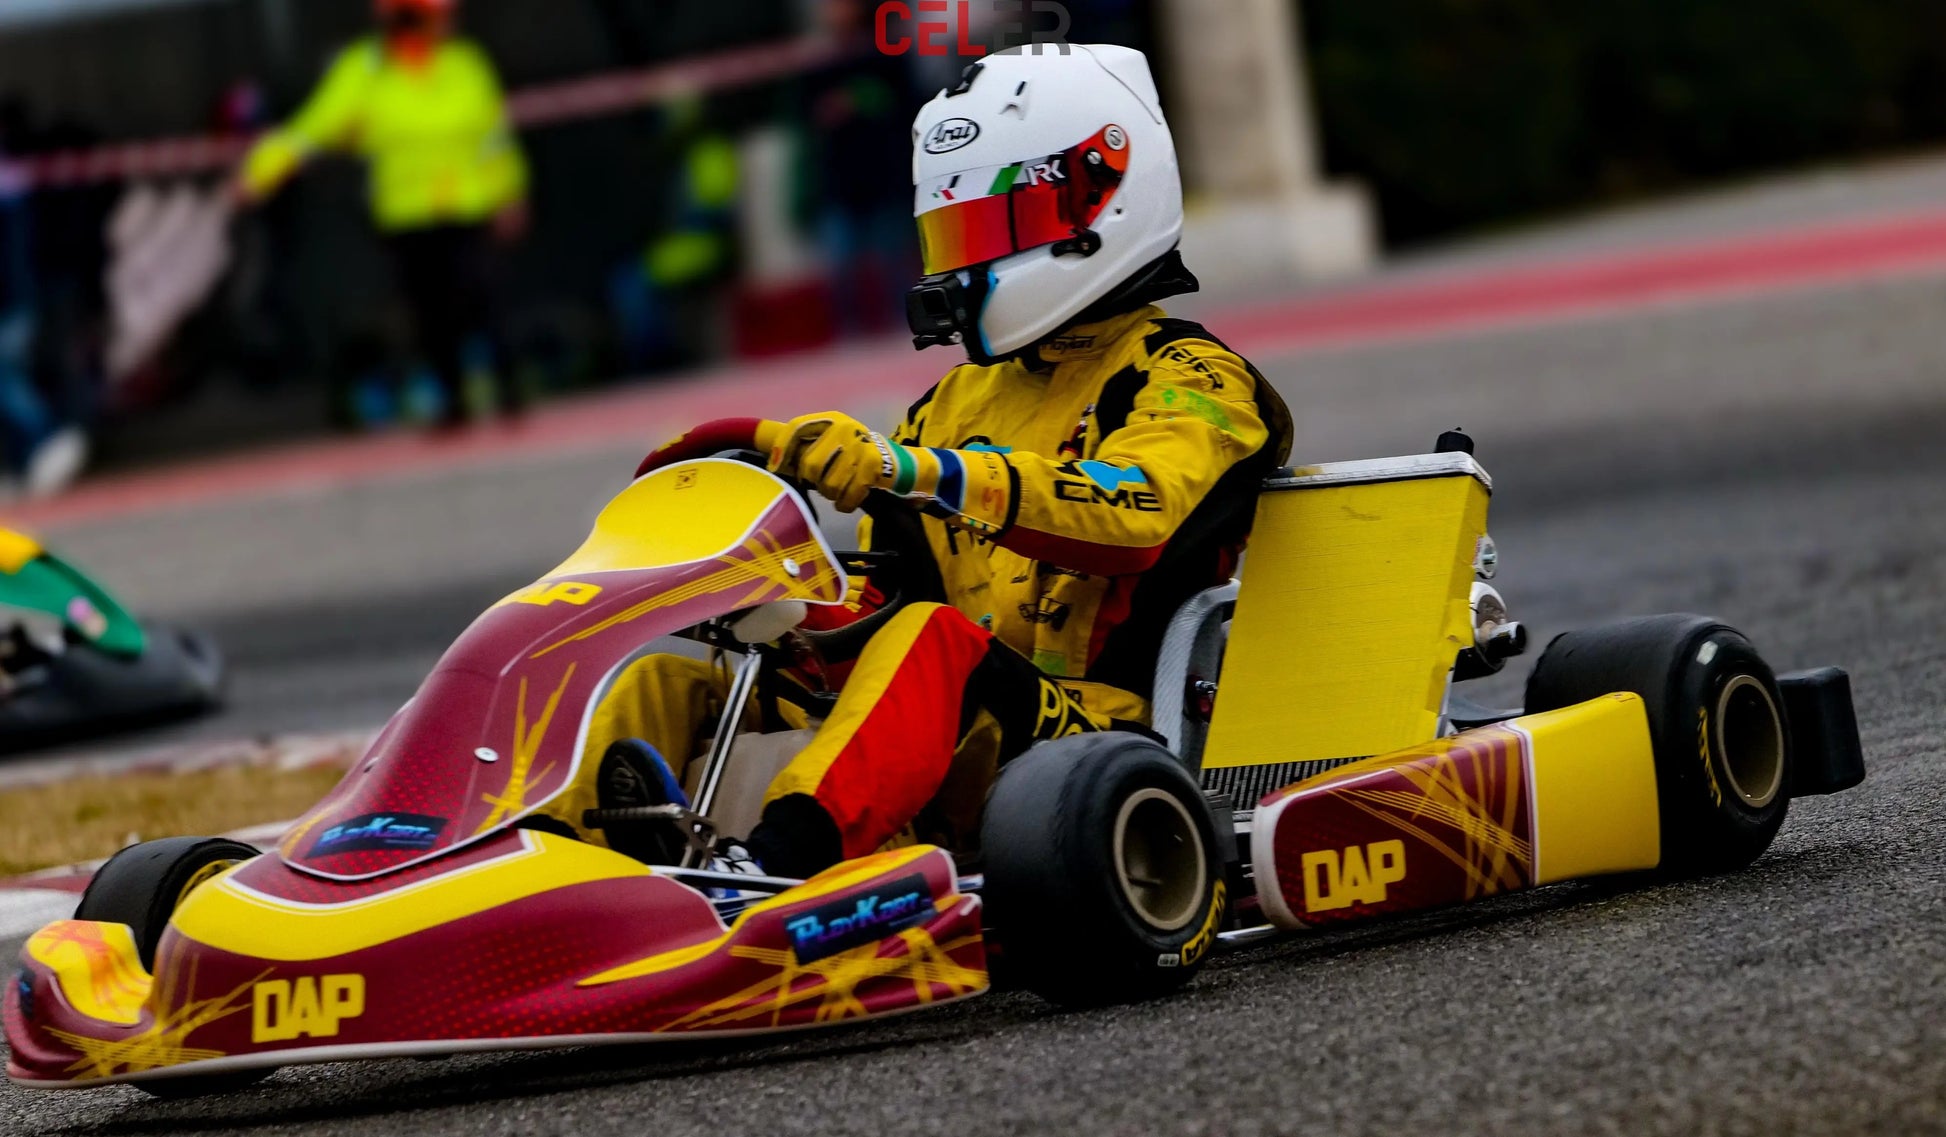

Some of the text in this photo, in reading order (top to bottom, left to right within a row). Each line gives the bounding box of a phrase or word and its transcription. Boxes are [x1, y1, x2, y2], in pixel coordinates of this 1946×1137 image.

[1054, 480, 1163, 512] CME
[1302, 839, 1406, 912] DAP
[252, 974, 365, 1043] DAP
